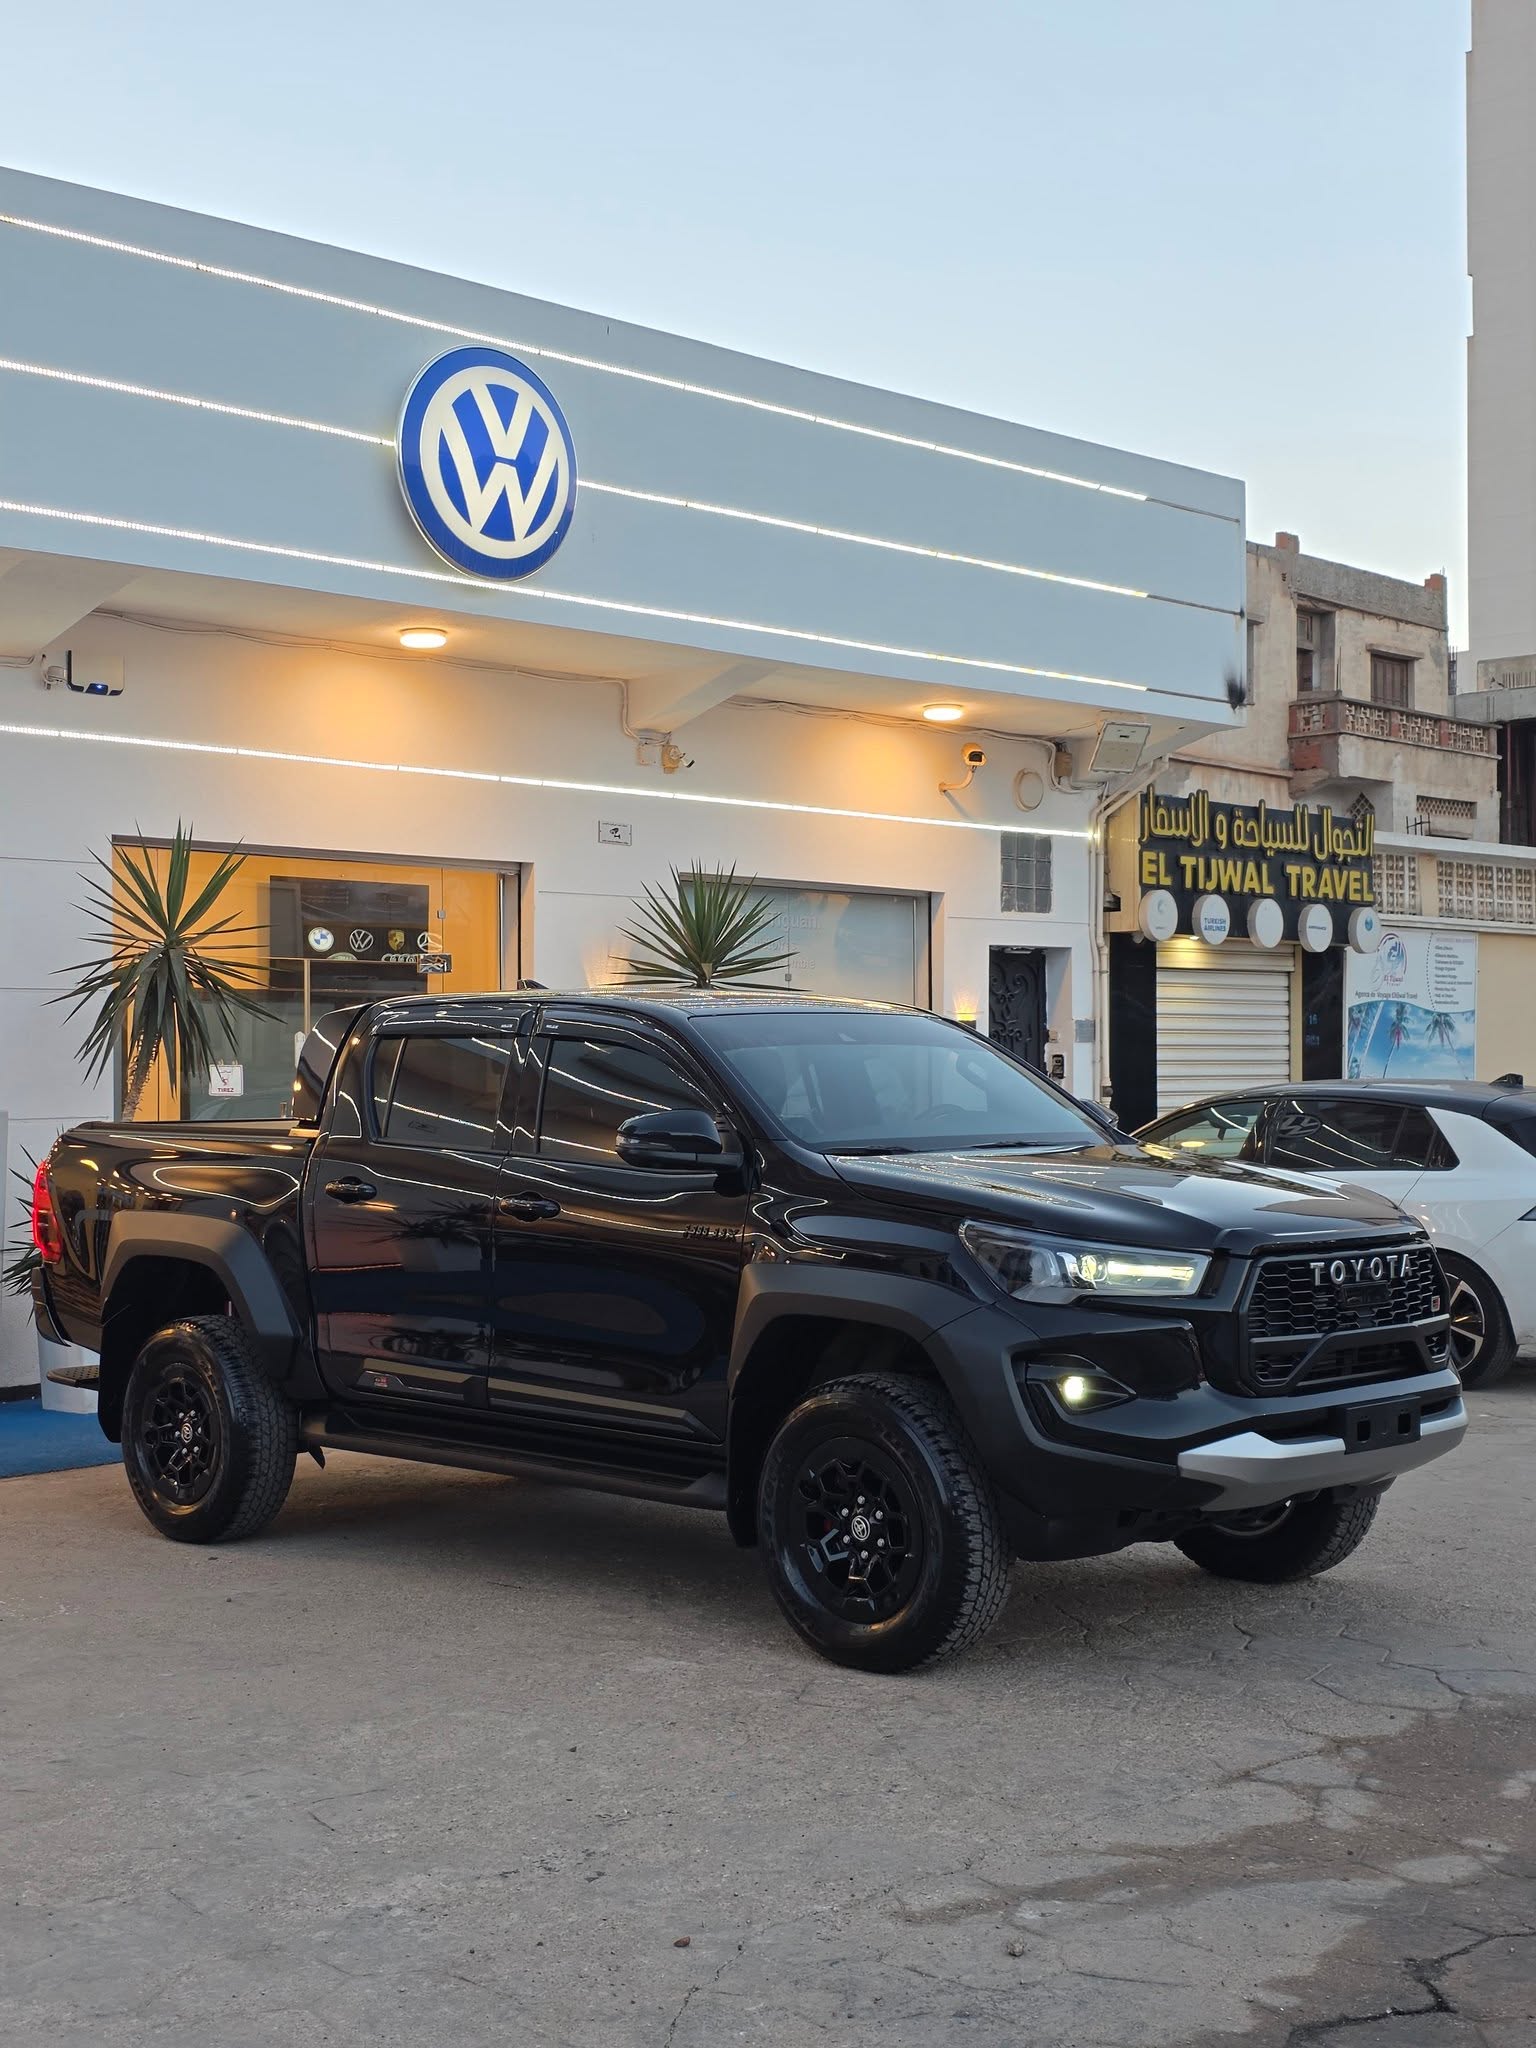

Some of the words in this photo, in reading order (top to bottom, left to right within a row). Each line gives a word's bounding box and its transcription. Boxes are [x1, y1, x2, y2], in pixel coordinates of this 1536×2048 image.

[1215, 811, 1227, 850] و
[1233, 798, 1310, 856] للسياحة
[1142, 851, 1173, 886] EL
[1180, 855, 1275, 894] TIJWAL
[1286, 864, 1374, 901] TRAVEL
[1310, 1253, 1413, 1286] TOYOTA
